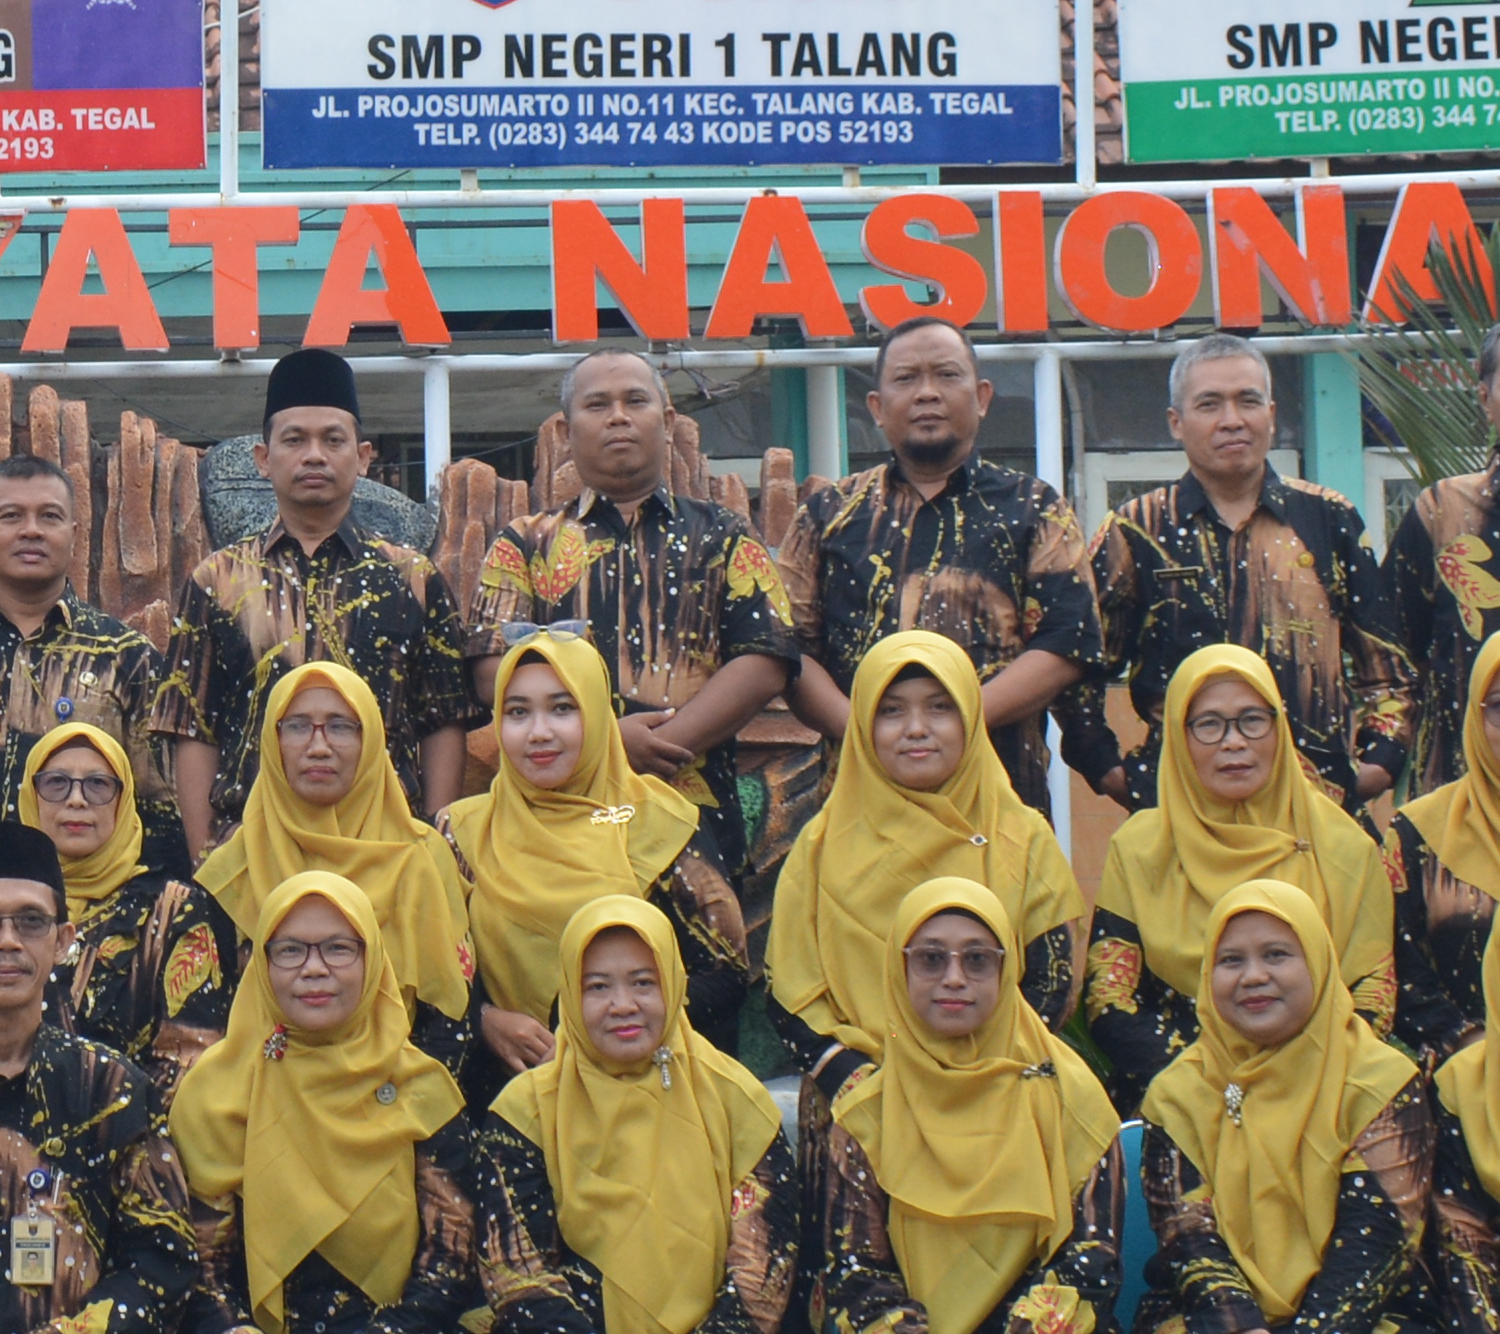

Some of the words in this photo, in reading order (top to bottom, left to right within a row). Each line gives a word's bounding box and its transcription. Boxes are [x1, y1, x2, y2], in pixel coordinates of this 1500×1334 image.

[368, 35, 481, 80] SMP
[504, 33, 690, 78] NEGERI
[715, 33, 735, 77] 1
[762, 32, 956, 77] TALANG
[1227, 23, 1337, 69] SMP
[312, 96, 349, 118] JL.
[358, 94, 569, 117] PROJOSUMARTO
[578, 95, 593, 115] II
[603, 94, 673, 115] NO.11
[685, 93, 743, 115] KEC.
[752, 93, 853, 114] TALANG
[862, 93, 921, 114] KAB.
[929, 93, 1012, 114] TEGAL
